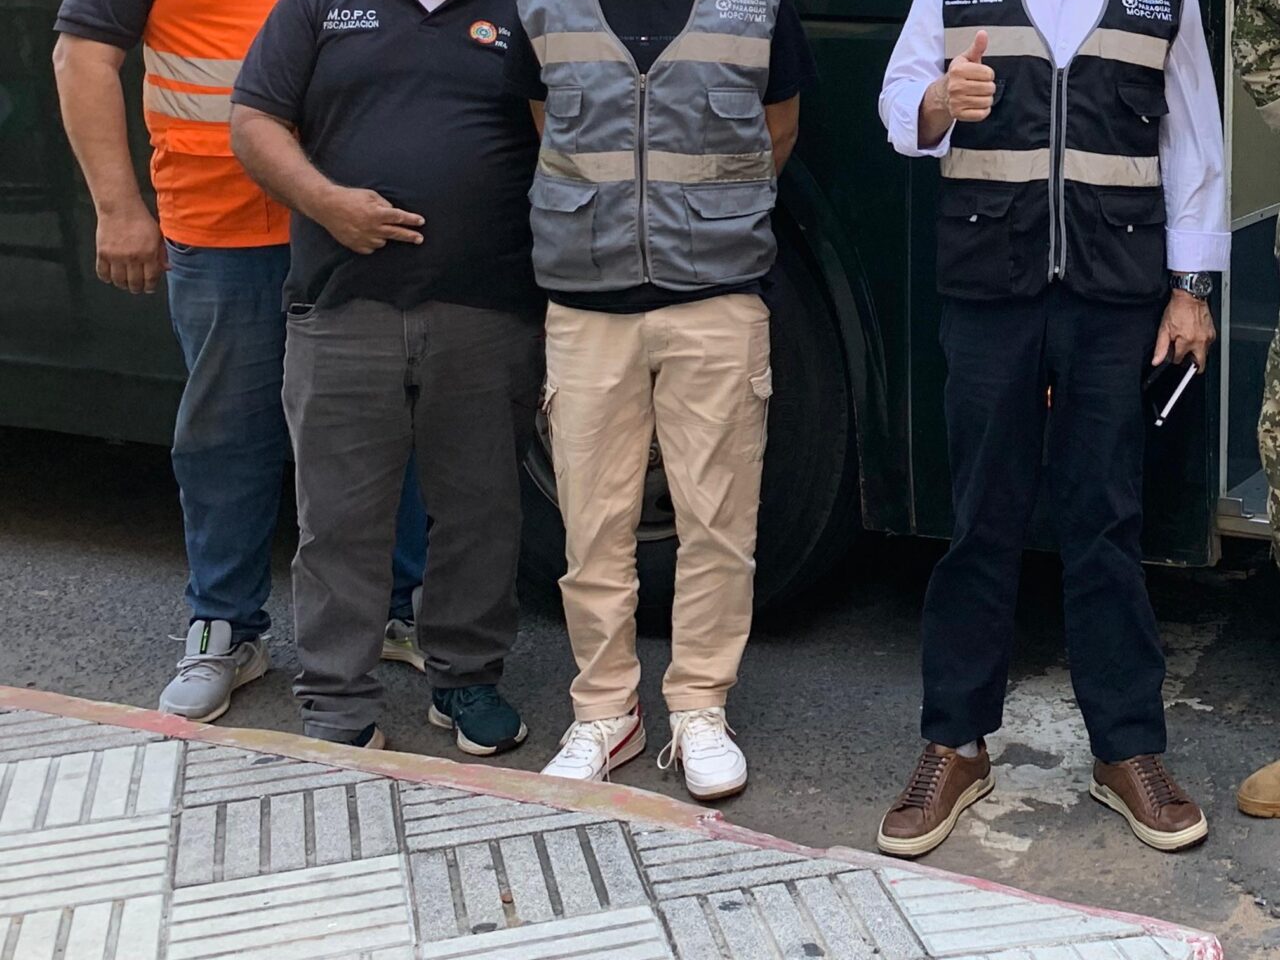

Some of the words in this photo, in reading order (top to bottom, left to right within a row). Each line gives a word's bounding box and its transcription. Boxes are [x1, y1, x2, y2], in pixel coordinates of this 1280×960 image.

[731, 4, 767, 14] PARAGUAY
[1138, 3, 1171, 13] PARAGUAY
[323, 20, 380, 30] FISCALIZACION
